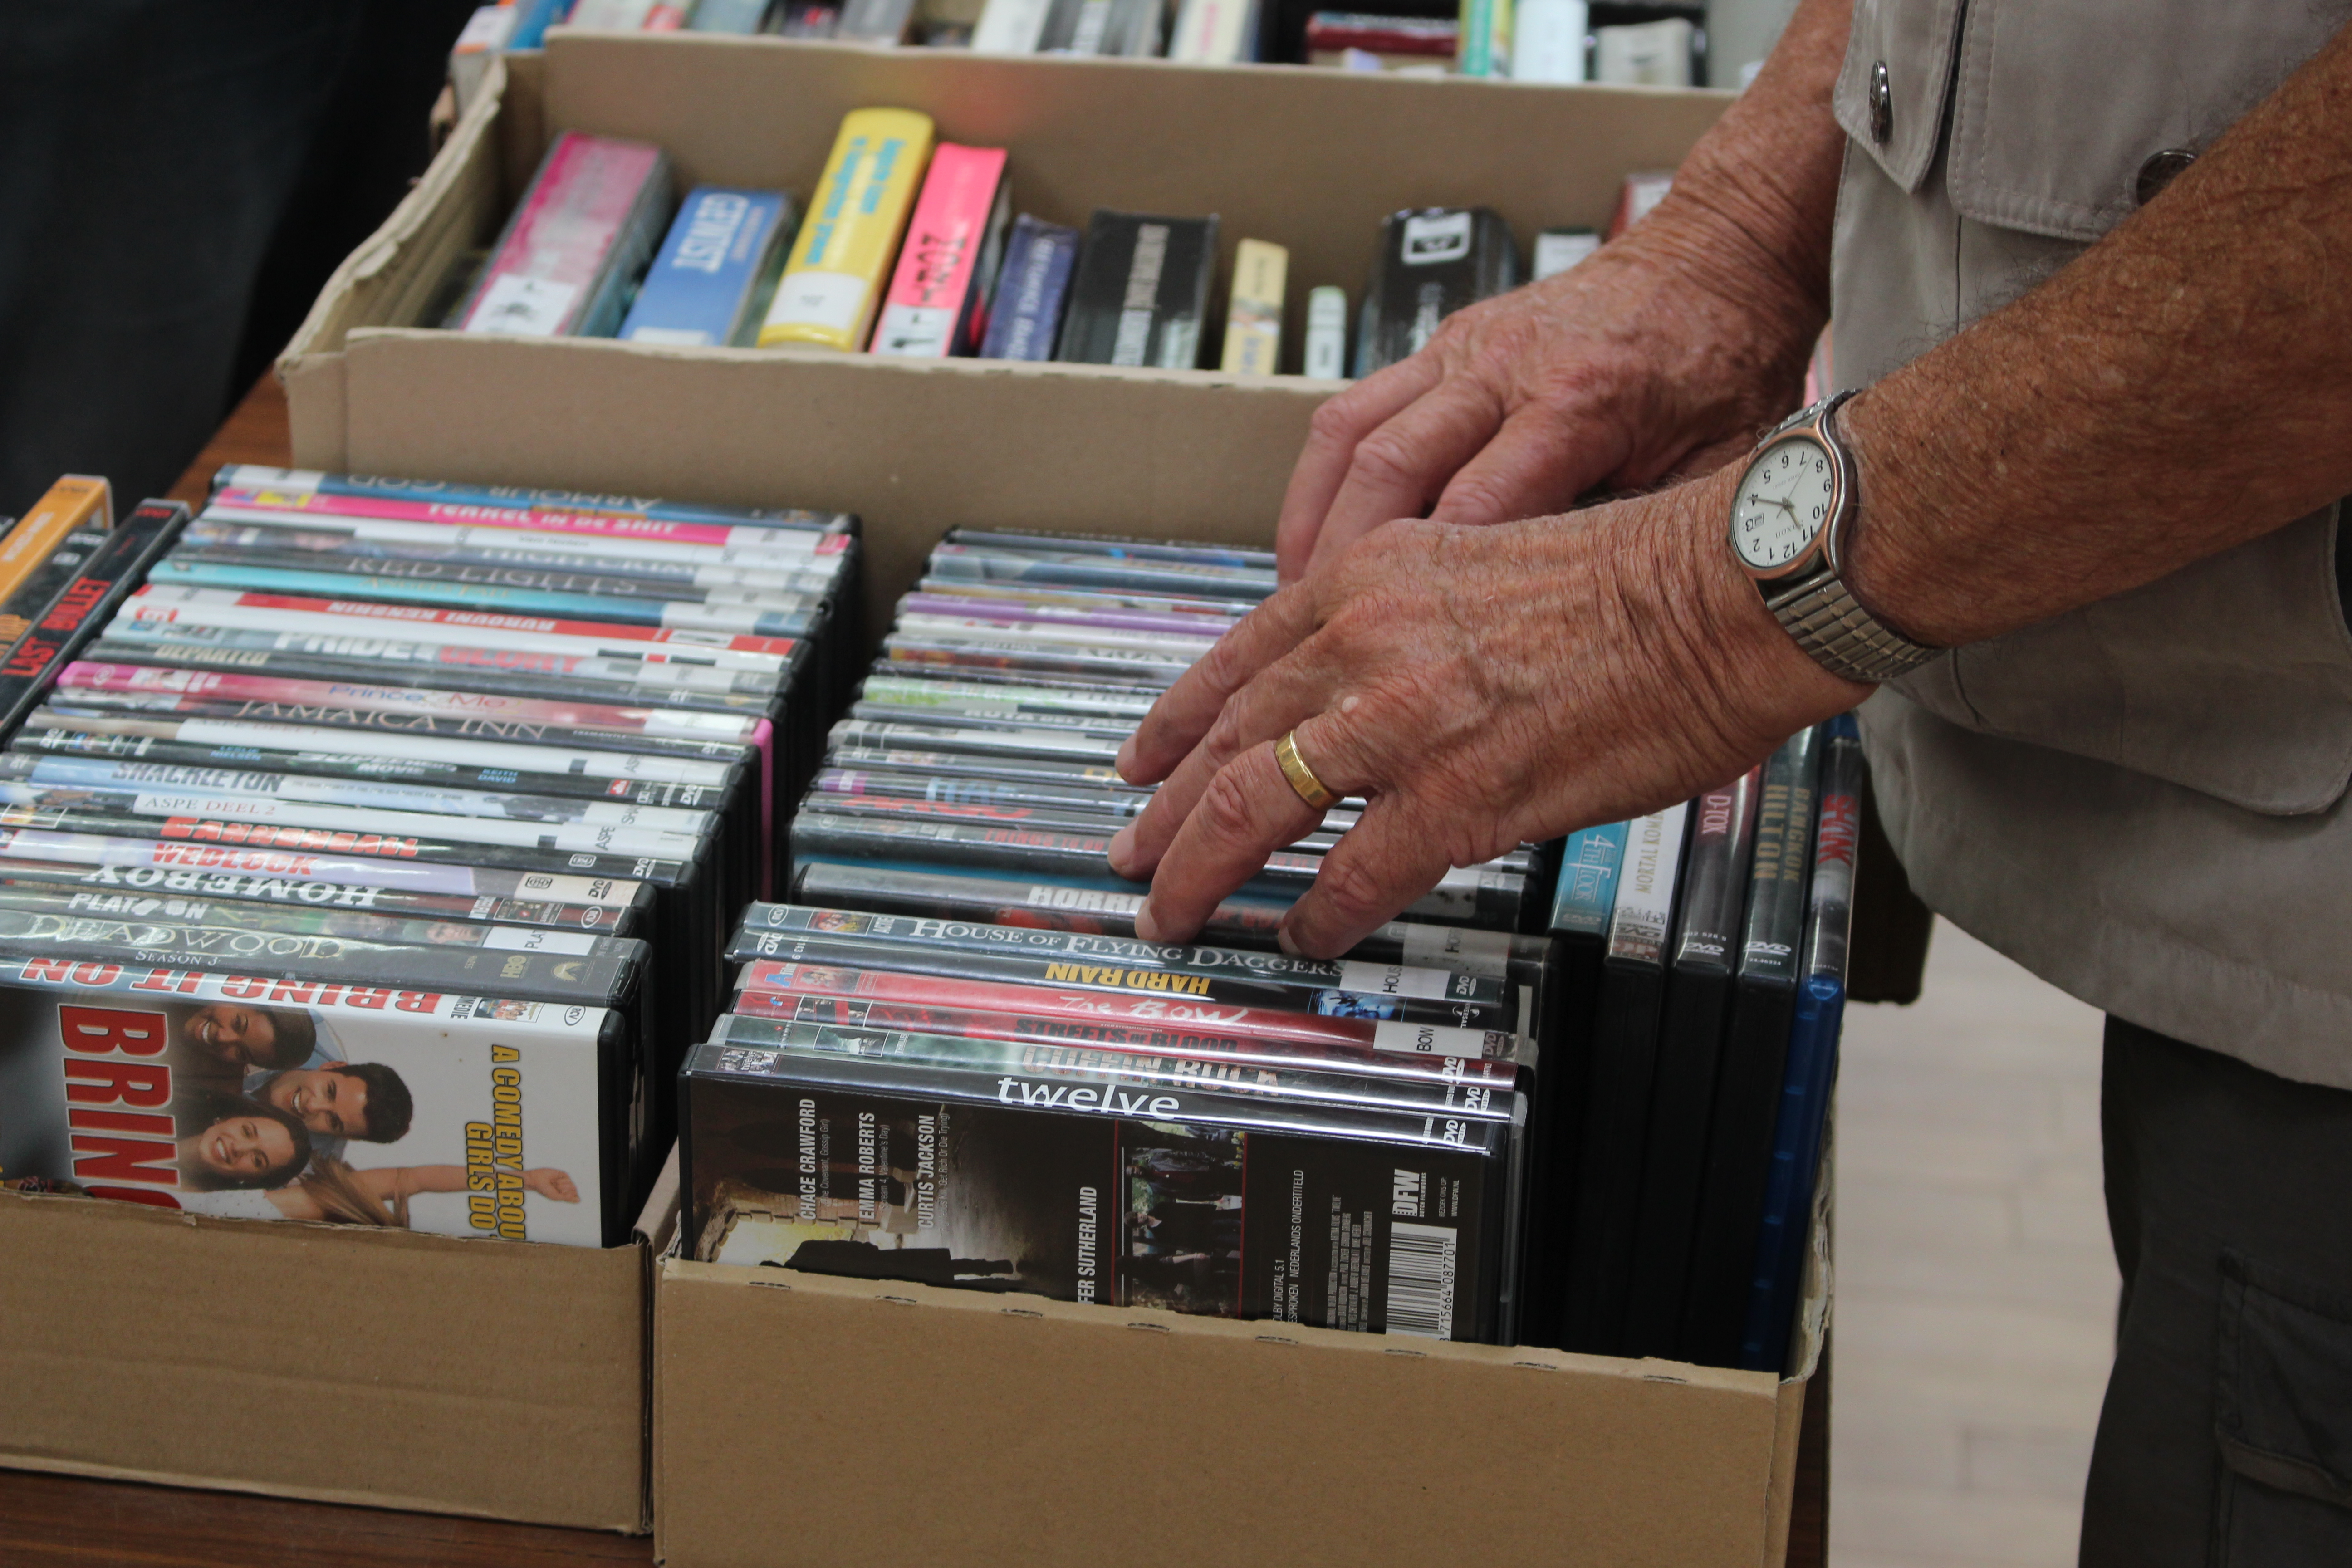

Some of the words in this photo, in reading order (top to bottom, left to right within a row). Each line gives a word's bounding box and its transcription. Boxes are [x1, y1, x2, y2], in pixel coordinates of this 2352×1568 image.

[1781, 455, 1789, 469] 6
[1799, 452, 1807, 465] 7
[1815, 459, 1823, 473] 8
[1764, 470, 1771, 484] 5
[1823, 478, 1831, 492] 9
[427, 503, 532, 524] TERKEL
[541, 513, 570, 527] IN
[573, 515, 606, 530] DE
[613, 518, 679, 534] SHIT
[1813, 503, 1828, 520] 10
[1753, 538, 1761, 553] 2
[1802, 525, 1817, 542] 11
[1769, 547, 1775, 560] 1
[1783, 542, 1798, 559] 12
[327, 600, 438, 622] KENSHIN
[444, 609, 557, 632] RUROUNI
[1, 635, 62, 678] LAST
[39, 575, 112, 632] BULLET
[274, 630, 413, 660] PRIDE
[438, 645, 586, 672] GLORY
[328, 684, 425, 701] Prince
[233, 699, 438, 731] JAMAICA
[456, 717, 545, 740] INN
[210, 750, 263, 761] NIELSEN
[111, 760, 286, 793] SHACKLETON
[477, 774, 517, 784] DAVID
[481, 768, 519, 777] KEITH
[144, 795, 200, 810] ASPE
[204, 801, 261, 815] DEEL
[264, 806, 276, 815] 2
[1701, 794, 1732, 835] D-TOX
[595, 825, 616, 851] ASPE
[984, 830, 1055, 847] THINGS
[1754, 784, 1788, 880] HILTON
[1783, 787, 1811, 883] BANGKOK
[152, 843, 320, 876] WEDLOCK
[1635, 839, 1659, 894] MORTAL
[80, 863, 386, 907] HOMEBOY
[1565, 862, 1612, 903] FLOOR
[68, 892, 210, 920] PLATOON
[26, 914, 345, 959] DEADWOOD
[764, 932, 785, 955] DVD
[909, 919, 1024, 943] HOUSE
[1028, 934, 1062, 946] OF
[1061, 935, 1183, 960] FLYING
[1187, 946, 1345, 977] DAGGERS
[1683, 941, 1725, 953] DVD
[1747, 941, 1792, 952] DVD
[135, 949, 201, 965] SEASON
[208, 956, 219, 966] 3
[500, 954, 528, 979] HBO
[19, 957, 124, 987] ON
[129, 968, 207, 995] IT
[1044, 962, 1122, 986] RAIN
[1126, 970, 1211, 995] HARD
[1456, 975, 1470, 995] DVD
[220, 974, 443, 1014] BRING
[1059, 996, 1112, 1014] The
[451, 996, 474, 1020] MEDIE
[895, 1034, 907, 1054] THRILLE
[1014, 1019, 1127, 1047] STREETS
[1129, 1031, 1149, 1044] OF
[1150, 1032, 1239, 1053] BLOOD
[1416, 1026, 1434, 1053] BOW
[1485, 1032, 1497, 1057] DVD
[491, 1044, 521, 1063] A
[1022, 1046, 1162, 1084] COFFIN
[1441, 1056, 1458, 1083] DVD
[998, 1077, 1180, 1120] twelve
[1464, 1086, 1481, 1112] DVD
[491, 1068, 523, 1171] COMEDY
[939, 1112, 951, 1134] Trying)
[1443, 1119, 1458, 1144] DVD
[799, 1099, 816, 1173] CRAWFORD
[820, 1134, 831, 1156] Gossip
[858, 1112, 875, 1174] ROBERTS
[917, 1114, 935, 1178] JACKSON
[939, 1136, 948, 1147] Die
[465, 1122, 495, 1191] GIRLS
[938, 1158, 948, 1173] Rich
[938, 1174, 948, 1186] Get
[1392, 1168, 1420, 1217] DFW
[496, 1172, 525, 1240] ABOU
[799, 1177, 816, 1220] CHACE
[859, 1178, 875, 1220] EMMA
[917, 1182, 935, 1228] CURTIS
[1292, 1169, 1303, 1224] ONDERTITELD
[1078, 1186, 1097, 1277] SUTHERLAND
[1289, 1225, 1301, 1277] NEDERLANDS
[1443, 1242, 1456, 1284] 087701
[1275, 1259, 1284, 1271] 5.1
[1077, 1279, 1095, 1305] FER
[1274, 1273, 1284, 1301] DIGITAL
[1288, 1284, 1299, 1323] ESPROKEN
[1439, 1290, 1452, 1332] 715664
